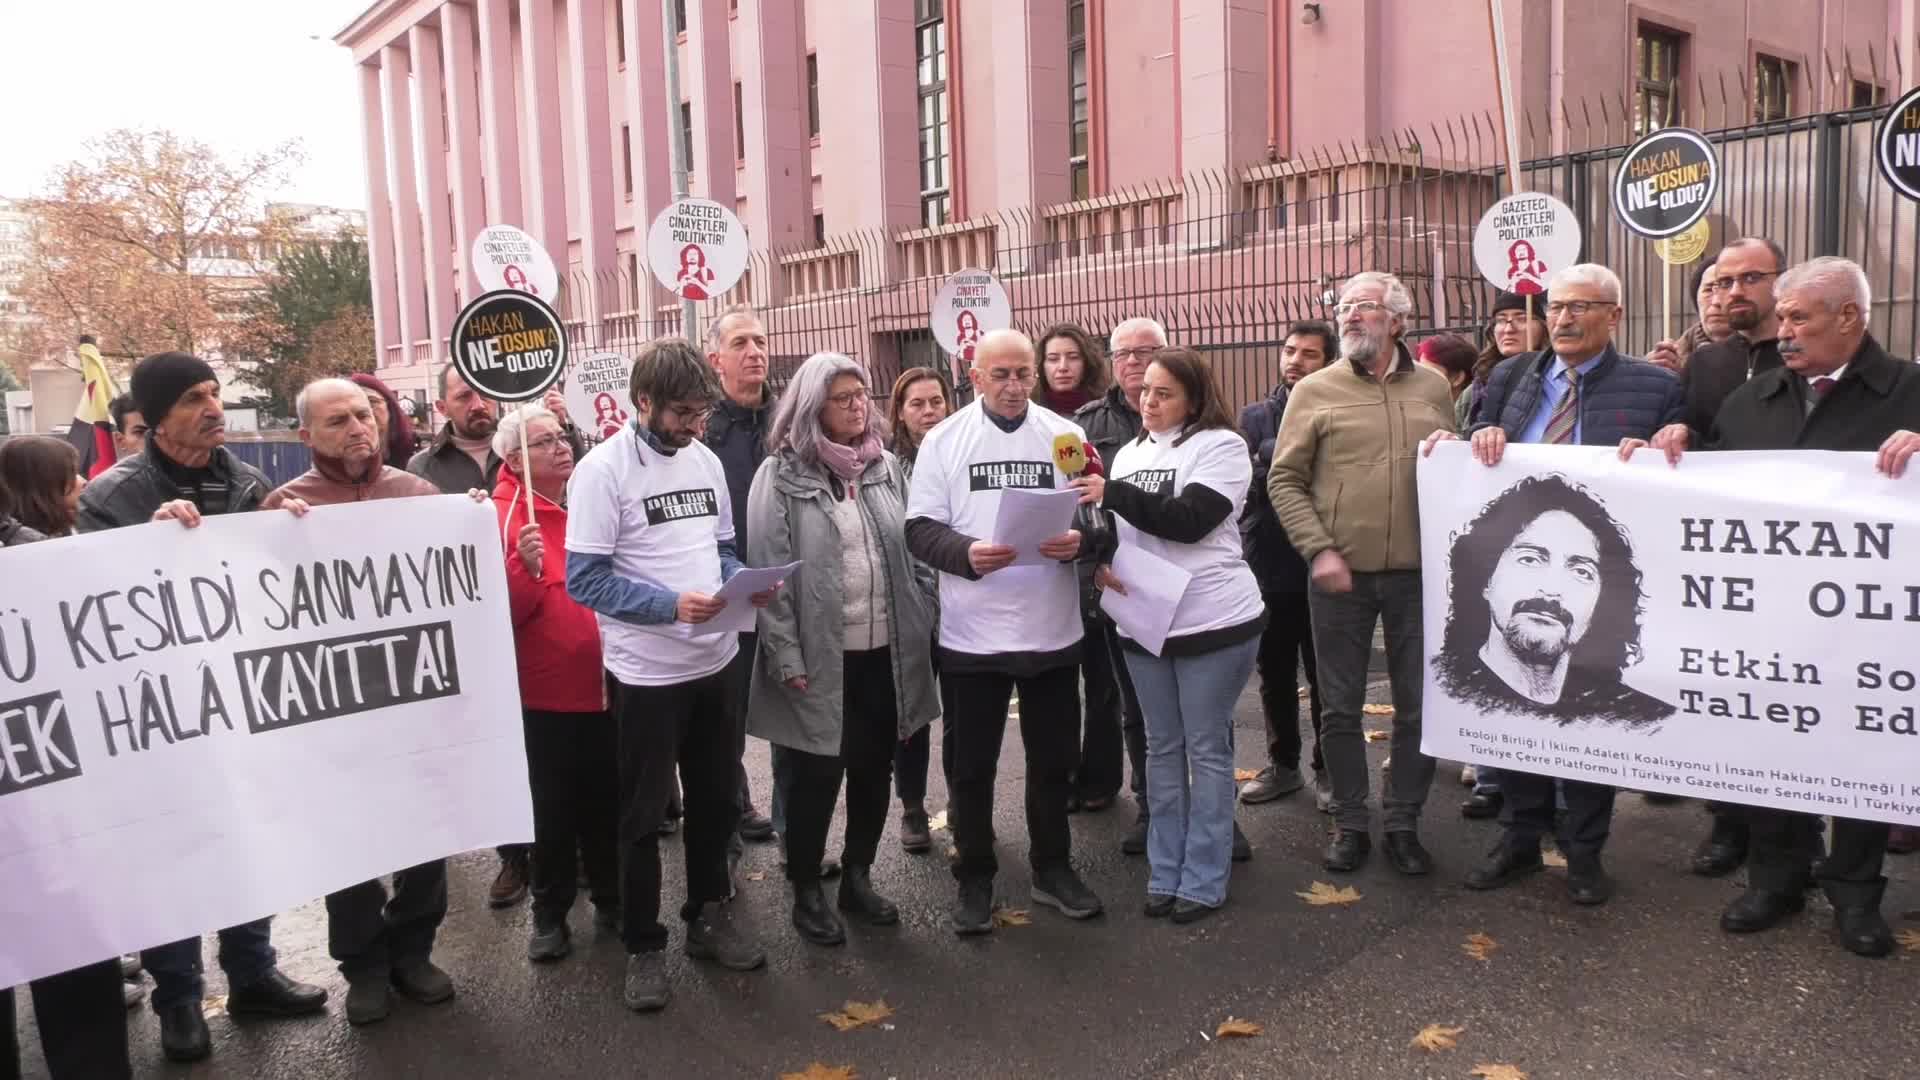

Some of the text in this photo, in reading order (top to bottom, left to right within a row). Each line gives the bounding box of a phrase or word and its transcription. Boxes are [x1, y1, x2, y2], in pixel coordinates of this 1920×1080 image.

[1904, 107, 1920, 128] H
[1630, 148, 1681, 178] HAKAN
[1896, 133, 1920, 167] N
[1652, 160, 1710, 191] TOSUN'A
[1627, 178, 1705, 211] NE OLDU?
[468, 312, 525, 337] HAKAN
[496, 327, 560, 354] TOSUN'A
[467, 338, 554, 373] NE OLDU?
[1681, 518, 1894, 560] HAKAN
[59, 560, 243, 670] KESİLDİ
[258, 543, 482, 631] SANMAYIN!
[1681, 574, 1754, 612] NE
[1678, 647, 1916, 692] Etkin So
[0, 627, 451, 784] EK HÂLÂ KAYITTA!
[1679, 689, 1919, 736] Talep Ed
[1458, 727, 1498, 743] Ekoloji
[1501, 734, 1538, 750] Birliği
[1584, 746, 1630, 761] Adaleti
[1634, 752, 1711, 773] Koalisyonu
[1769, 770, 1825, 786] Hakları
[1831, 777, 1895, 796] Derneği
[1469, 743, 1512, 759] Türkiye
[1515, 751, 1551, 765] Çevre
[1554, 757, 1618, 775] Platformu
[1631, 767, 1681, 784] Türkiye
[1686, 775, 1769, 795] Gazeteciler
[1775, 784, 1848, 805] Sendikası
